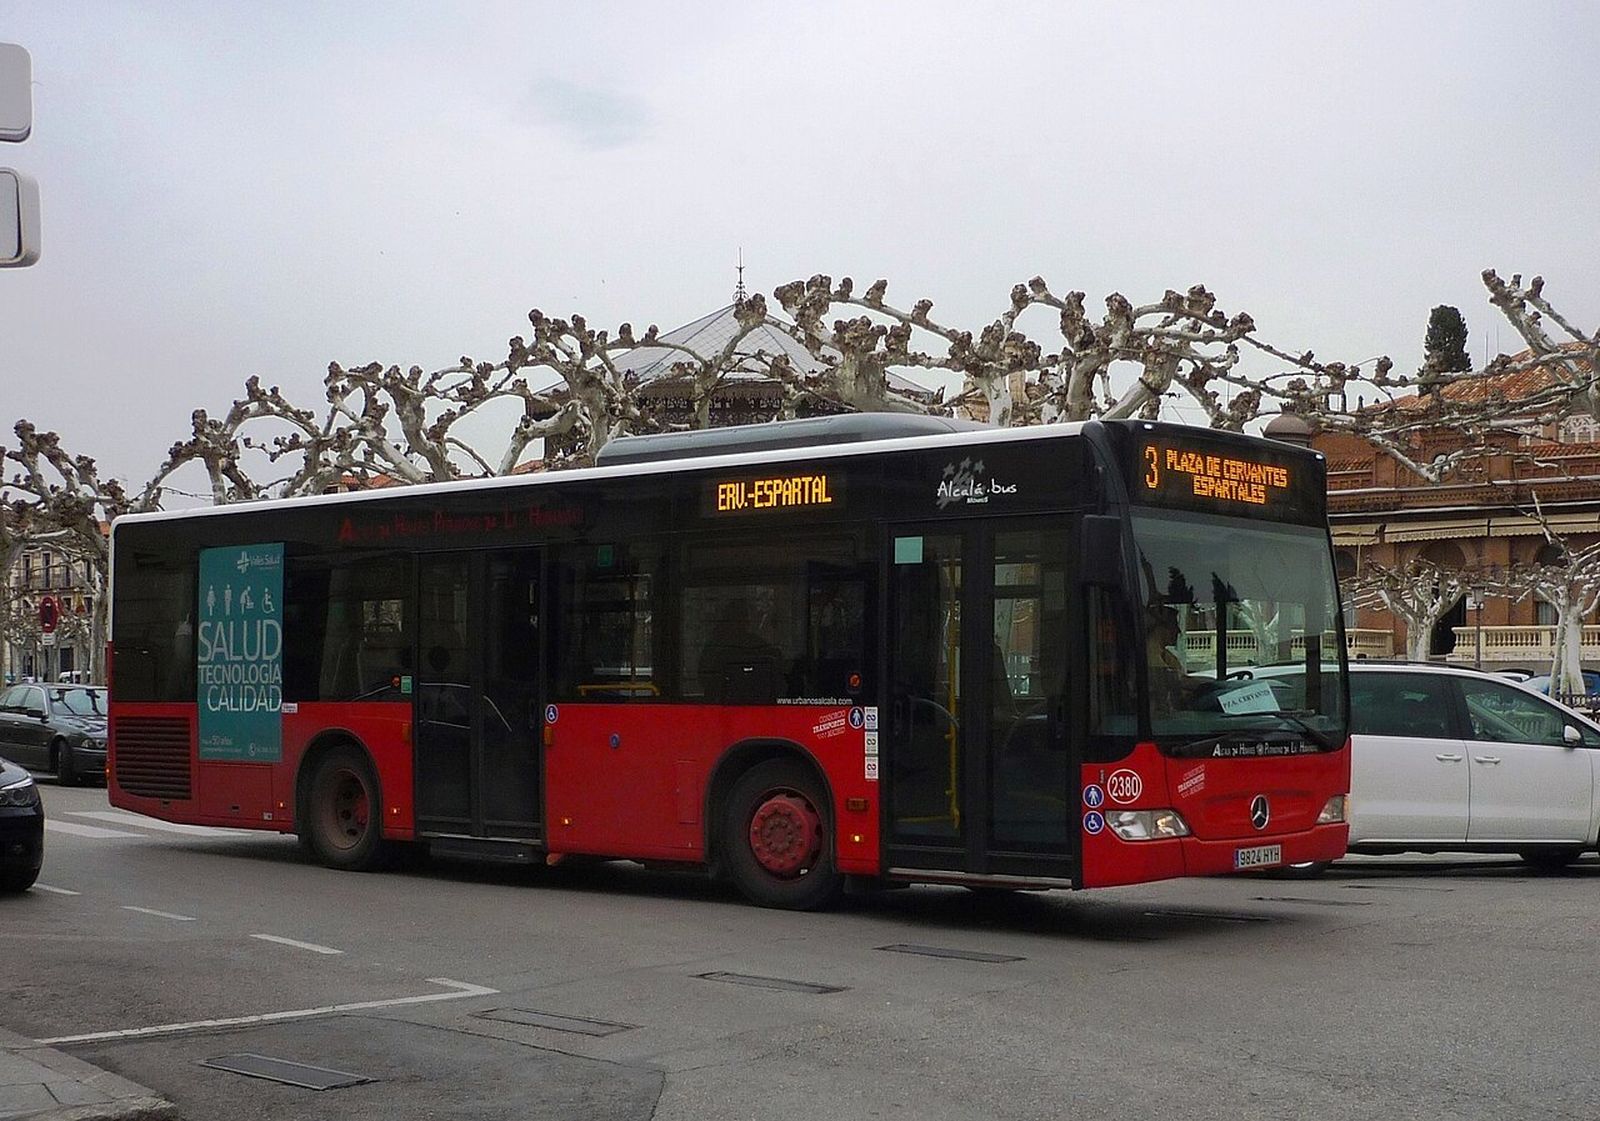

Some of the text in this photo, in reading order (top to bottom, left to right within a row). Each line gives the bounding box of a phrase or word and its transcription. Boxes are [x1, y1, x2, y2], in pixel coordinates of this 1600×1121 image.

[1144, 446, 1159, 489] 3
[1166, 449, 1288, 488] PLAZA DE CERVANTES
[1193, 475, 1266, 505] ESPARTALES
[198, 620, 282, 662] SALUD
[207, 685, 282, 712] CALIDAD
[1110, 775, 1138, 797] 2380
[1240, 850, 1261, 865] 9824
